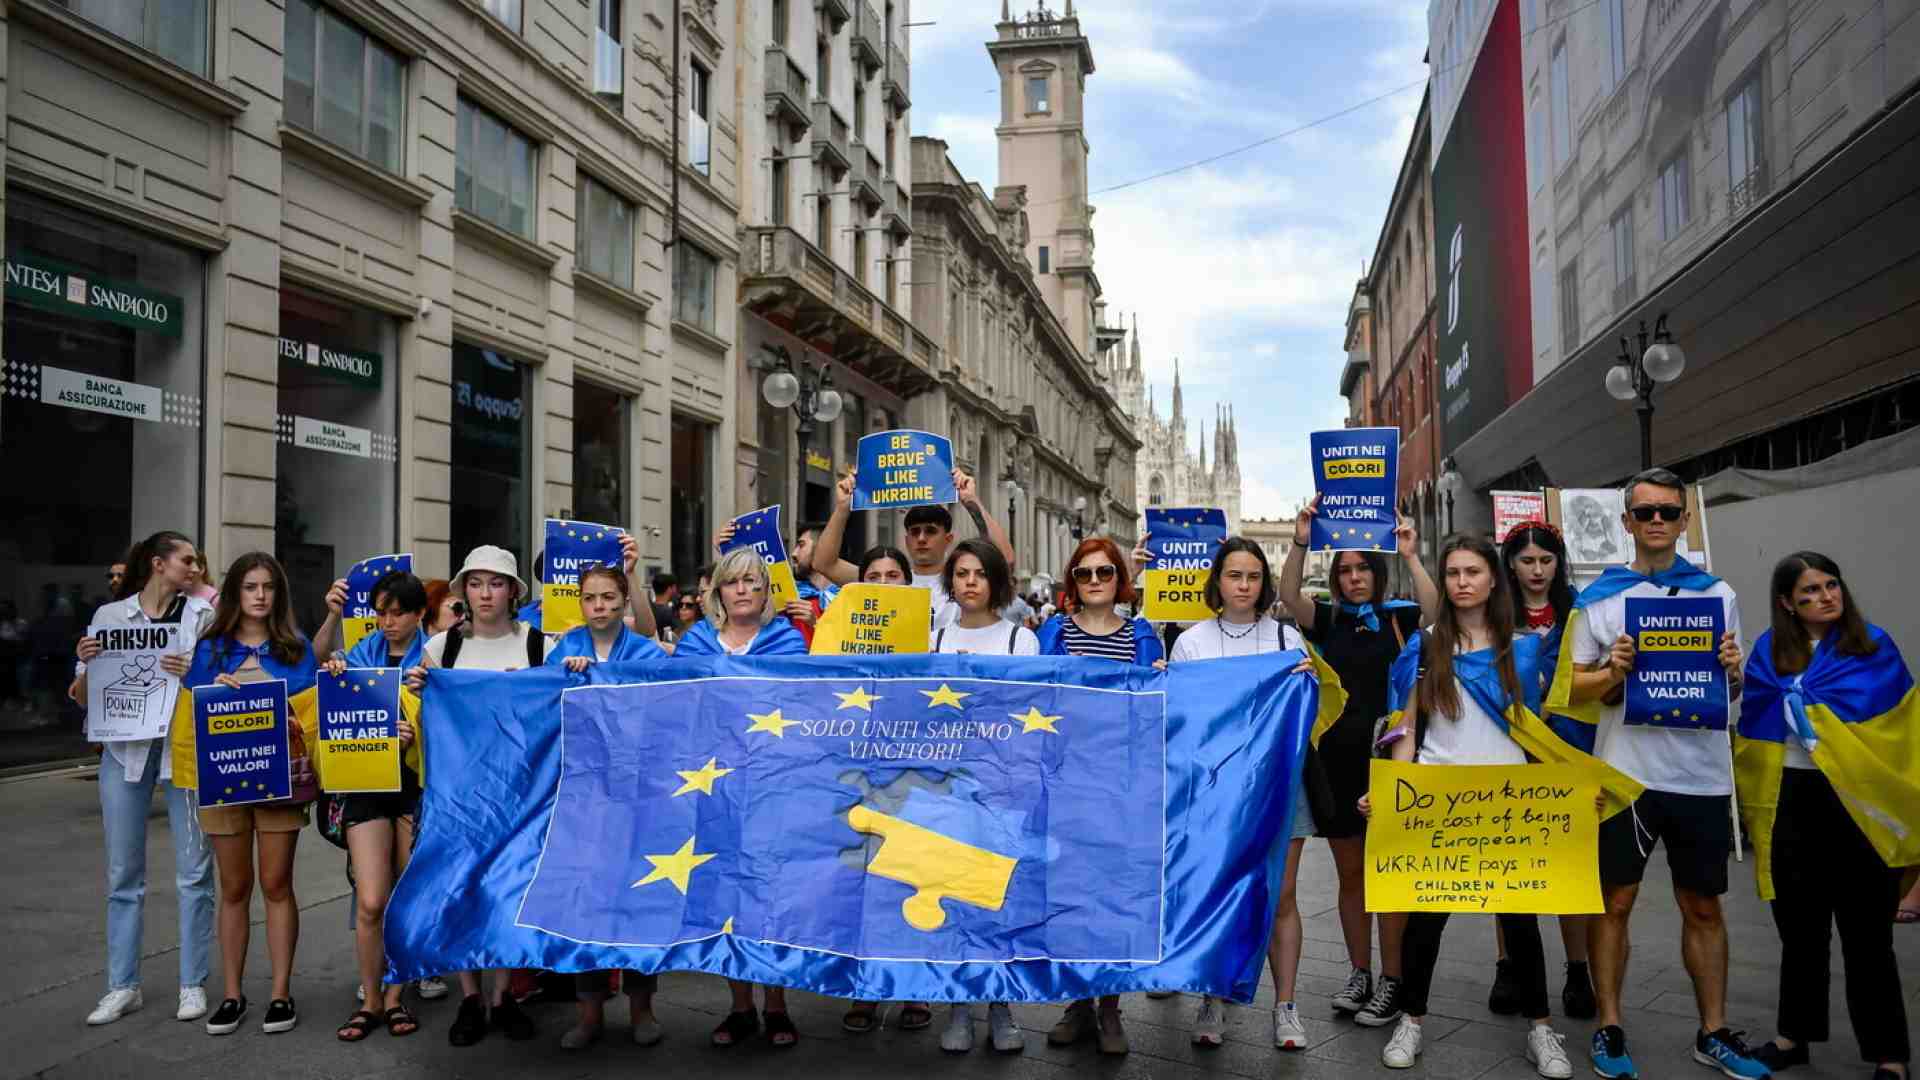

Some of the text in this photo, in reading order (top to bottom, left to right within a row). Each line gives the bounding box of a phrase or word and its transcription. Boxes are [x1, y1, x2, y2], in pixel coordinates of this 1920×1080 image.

[5, 261, 168, 323] NTESA SANPAOLO
[279, 337, 373, 377] TESA SANPAOLO
[86, 380, 123, 396] BANCA
[58, 389, 147, 415] ASSICURAZIONE
[322, 425, 346, 438] BANCA
[891, 435, 911, 449] BE
[1322, 445, 1386, 457] UNITI NEI
[1328, 463, 1380, 474] COLORI
[885, 470, 918, 485] LIKE
[1322, 495, 1385, 506] UNITI NEI
[1327, 508, 1378, 519] VALORI
[1162, 542, 1208, 554] UNITI
[1157, 558, 1213, 571] SIAMO
[552, 573, 579, 585] WE
[552, 588, 582, 598] STRO
[1158, 590, 1205, 602] FORT
[864, 599, 879, 611] BE
[1639, 616, 1713, 627] UNITI NEI
[856, 628, 882, 641] LIKE
[1644, 636, 1707, 647] COLORI
[1639, 671, 1712, 682] UNITI NEI
[1646, 687, 1705, 699] VALORI
[207, 698, 274, 713] UNITI NEI
[213, 716, 269, 730] COLORI
[327, 709, 389, 724] UNITED
[328, 727, 389, 740] WE ARE
[799, 719, 1013, 741] SOLO UNITI SAREMO
[209, 744, 276, 761] UNITI NEI
[329, 742, 389, 753] STRONGER
[849, 741, 963, 761] VINCITORI!
[218, 759, 270, 774] VALORI
[1395, 778, 1574, 815] Do you know
[1403, 808, 1571, 833] the cost of being
[1431, 827, 1550, 855] European ?
[1376, 855, 1547, 877] UKRAINE pays in
[1414, 880, 1547, 892] CHILDREN LIVES
